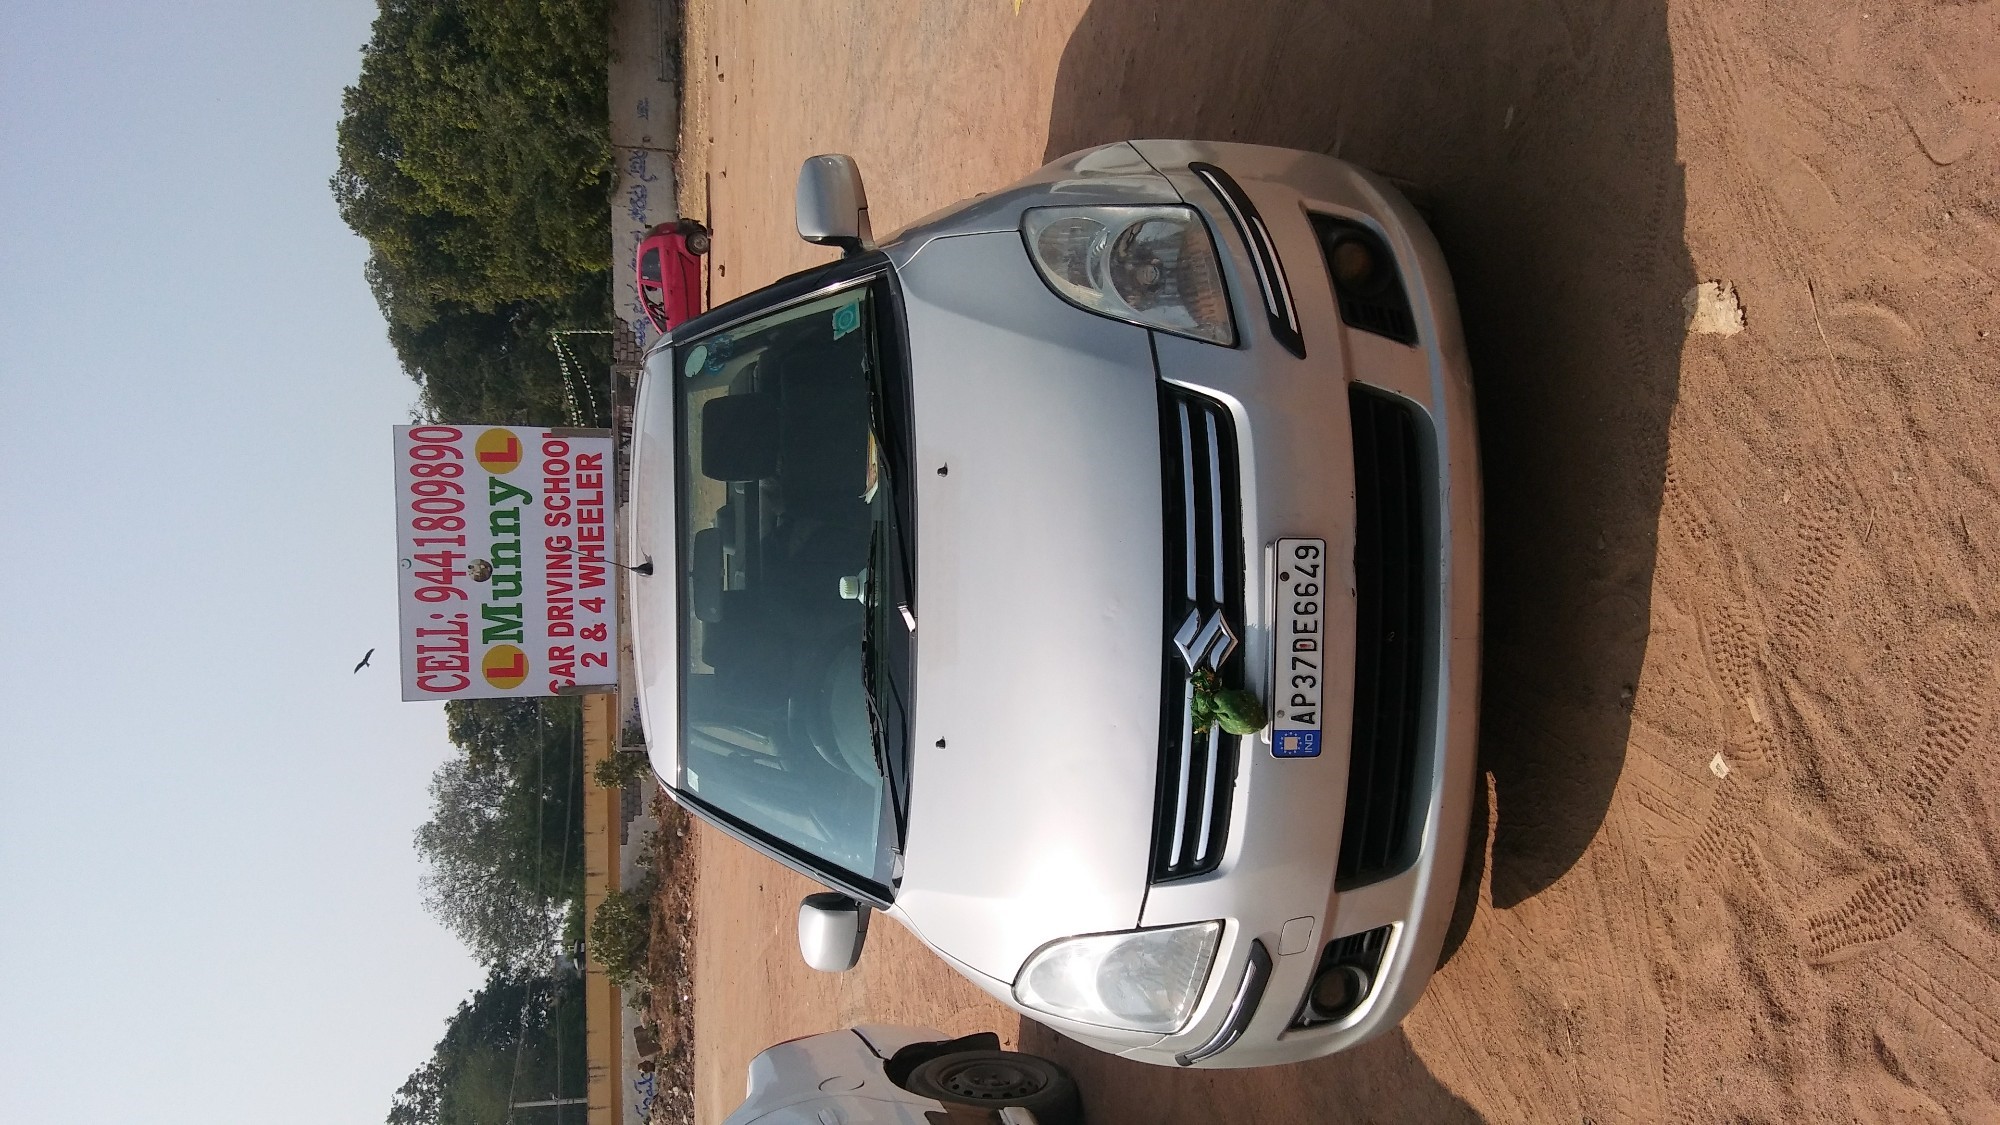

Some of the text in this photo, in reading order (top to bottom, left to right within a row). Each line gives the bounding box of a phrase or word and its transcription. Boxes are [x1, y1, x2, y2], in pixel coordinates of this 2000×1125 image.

[408, 426, 471, 693] CELL: 9441809890
[479, 437, 533, 678] L Munny L
[544, 535, 575, 637] DRIVING
[575, 452, 608, 668] 2 & 4 WHEELER
[1290, 545, 1320, 725] AP37DE6649
[548, 644, 576, 694] CAR
[1304, 733, 1313, 753] IND
